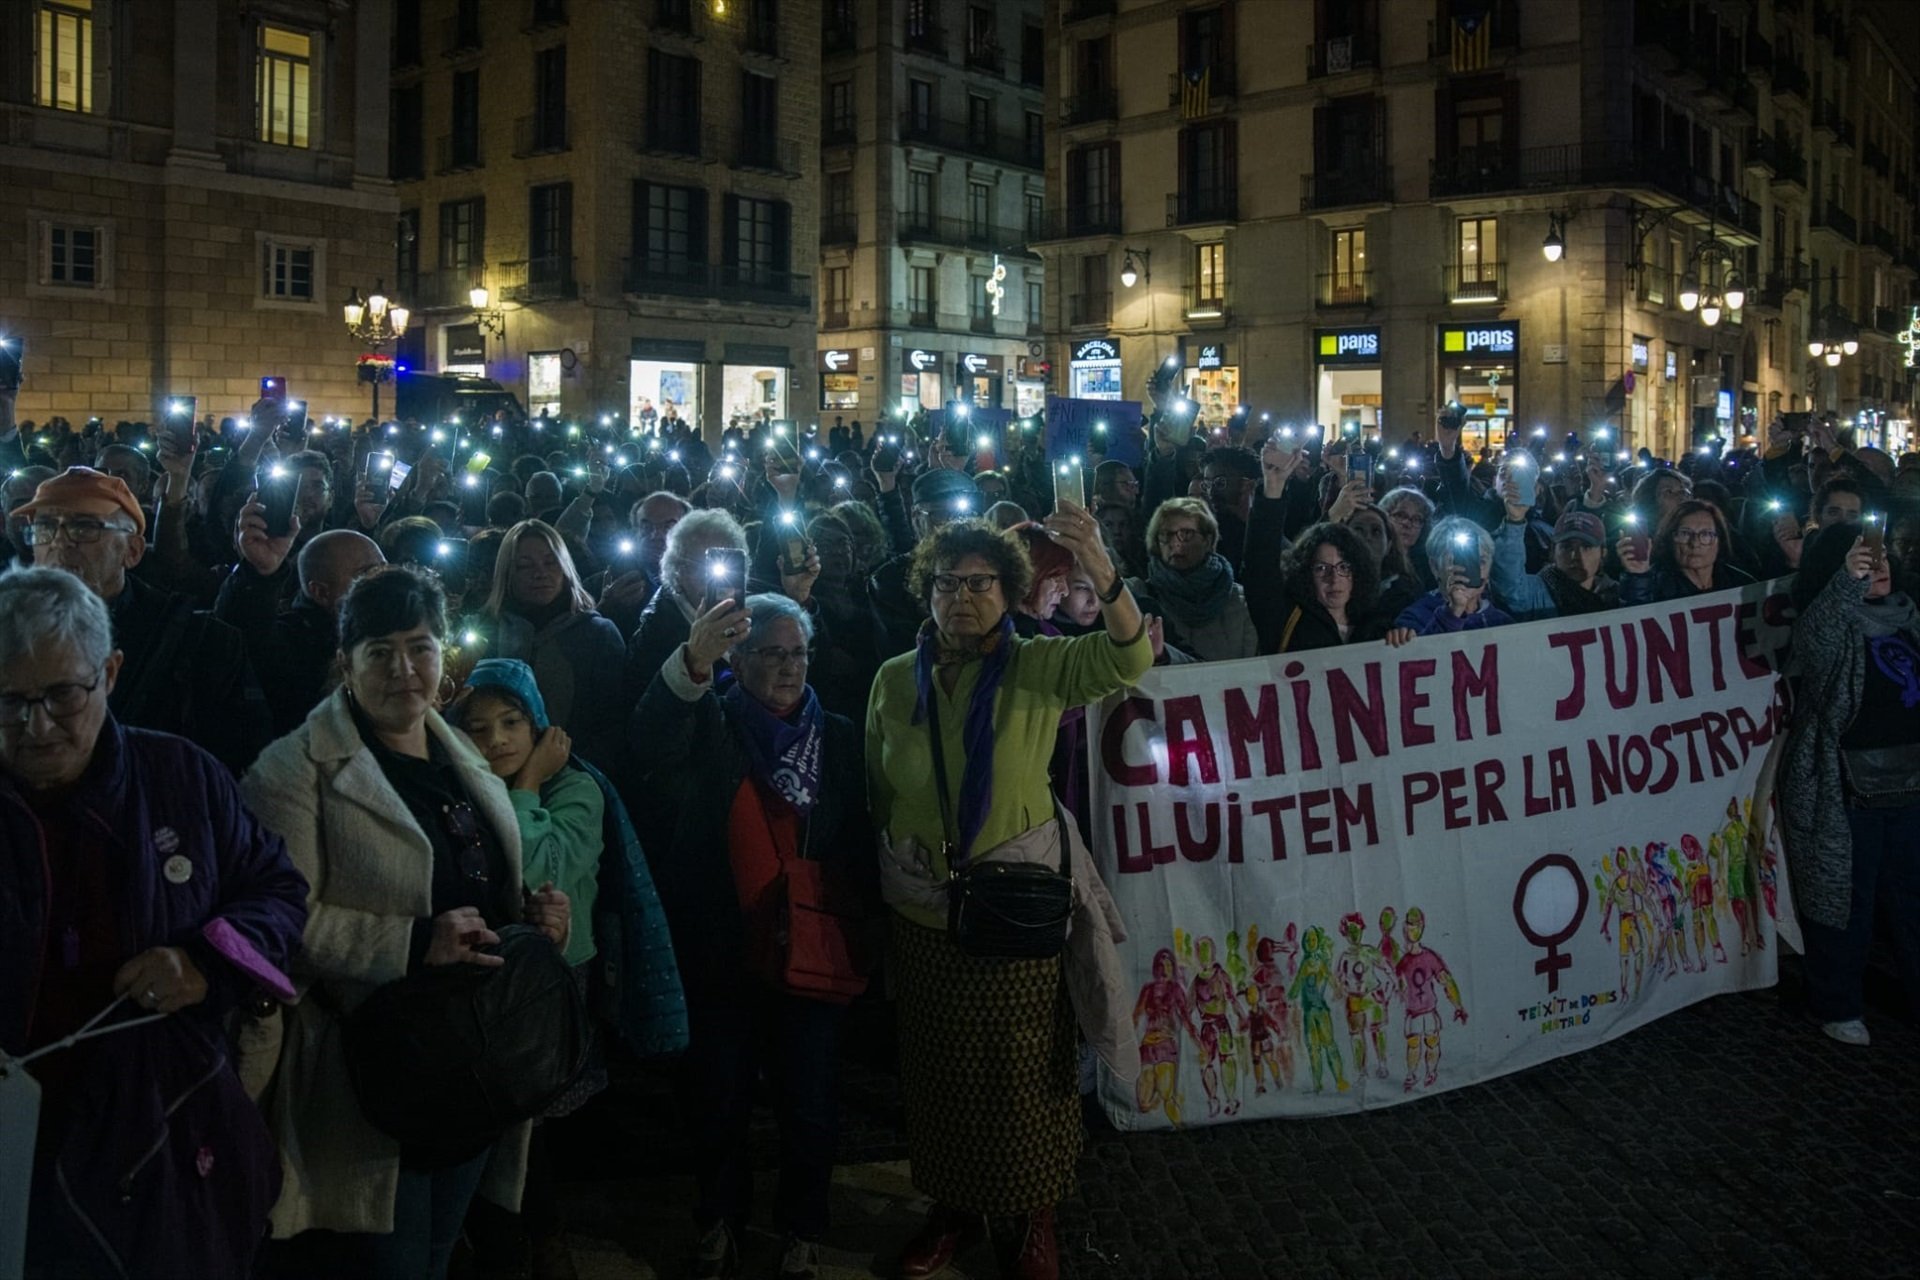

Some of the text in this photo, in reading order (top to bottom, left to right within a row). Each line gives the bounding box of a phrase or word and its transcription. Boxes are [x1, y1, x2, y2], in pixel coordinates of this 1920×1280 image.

[1338, 334, 1377, 354] pans
[1466, 330, 1513, 351] pans
[1199, 357, 1220, 369] pans
[1404, 759, 1507, 835] PER
[1523, 747, 1576, 817] LA
